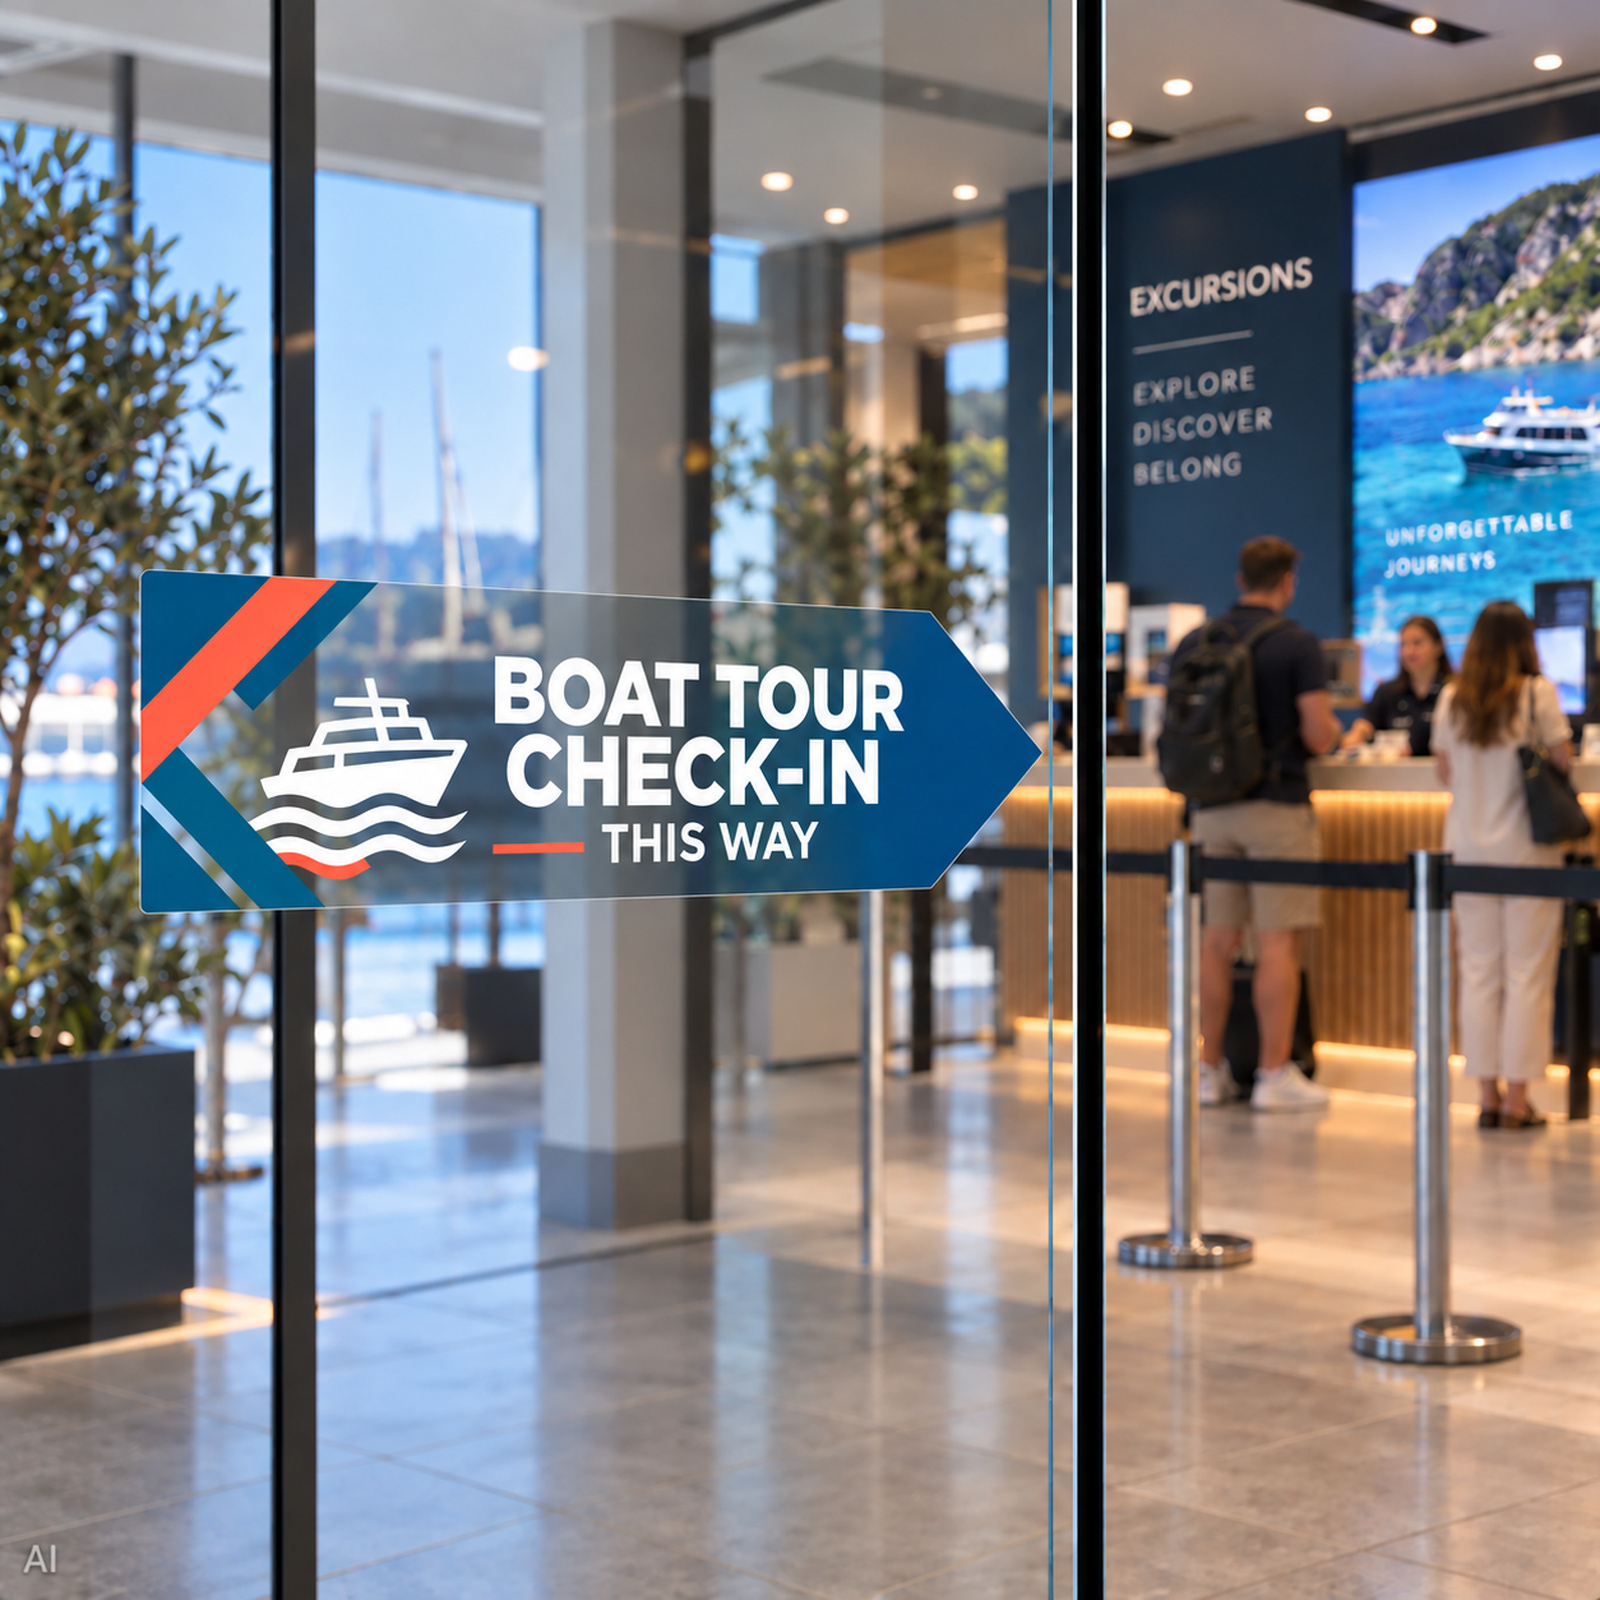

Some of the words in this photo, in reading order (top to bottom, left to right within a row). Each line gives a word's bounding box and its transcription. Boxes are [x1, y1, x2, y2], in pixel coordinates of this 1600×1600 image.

[1130, 256, 1313, 317] EXCURSIONS
[1133, 365, 1255, 406] EXPLORE
[1133, 406, 1273, 446] DISCOVER
[1133, 451, 1242, 486] BELONG
[1385, 510, 1573, 547] UNFORGETTABLE
[1384, 550, 1496, 579] JOURNEYS
[494, 656, 700, 727] BOAT
[715, 664, 904, 732] TOUR
[506, 733, 879, 808] CHECK-IN
[602, 822, 706, 863] THIS
[719, 821, 819, 861] WAY
